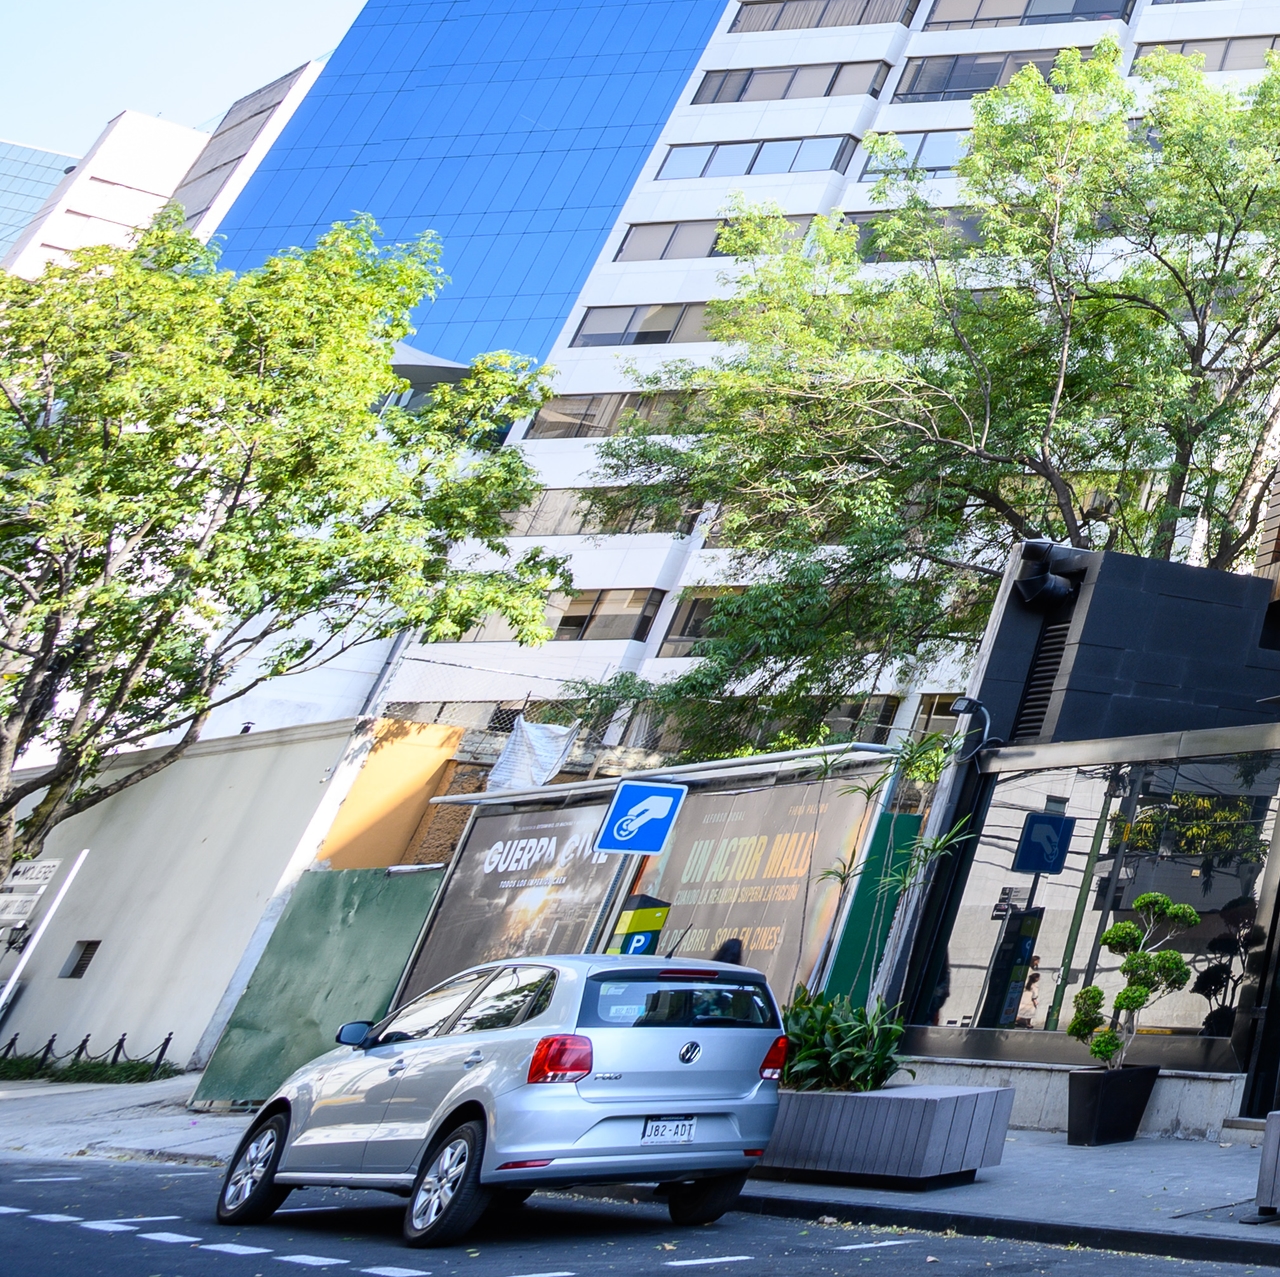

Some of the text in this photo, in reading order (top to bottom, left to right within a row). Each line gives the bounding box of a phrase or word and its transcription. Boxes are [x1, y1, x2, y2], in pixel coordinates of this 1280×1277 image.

[484, 836, 557, 874] GUERRA
[680, 831, 819, 884] UN ACTOR MALO
[628, 935, 646, 955] P
[660, 930, 669, 952] 4
[681, 928, 710, 952] ABRIL
[750, 925, 780, 951] CINES
[594, 1072, 622, 1081] POLO
[646, 1123, 694, 1138] J82-ADT
